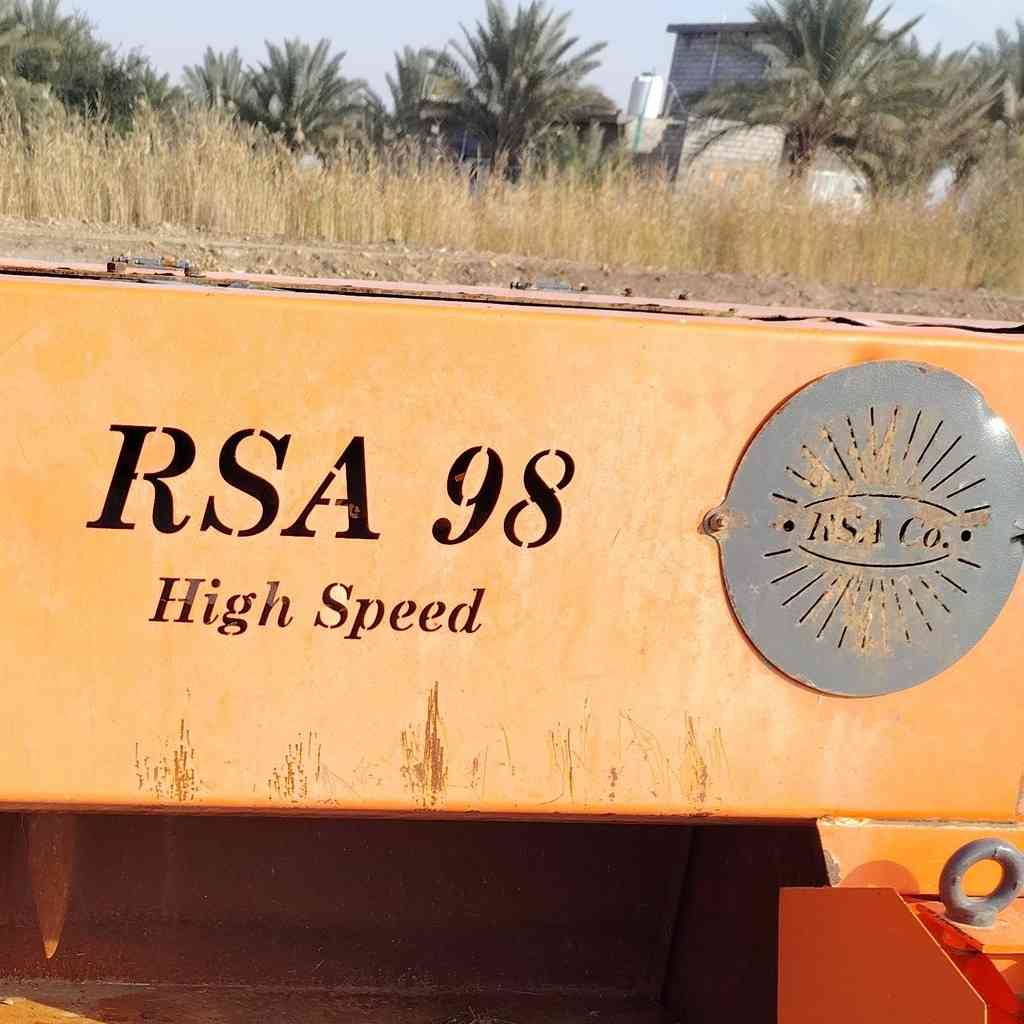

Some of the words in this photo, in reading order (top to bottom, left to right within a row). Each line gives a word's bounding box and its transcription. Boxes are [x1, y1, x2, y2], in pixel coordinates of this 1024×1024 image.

[86, 424, 381, 541] RSA
[432, 445, 576, 549] 98
[148, 576, 294, 636] High
[313, 582, 486, 640] Speed
